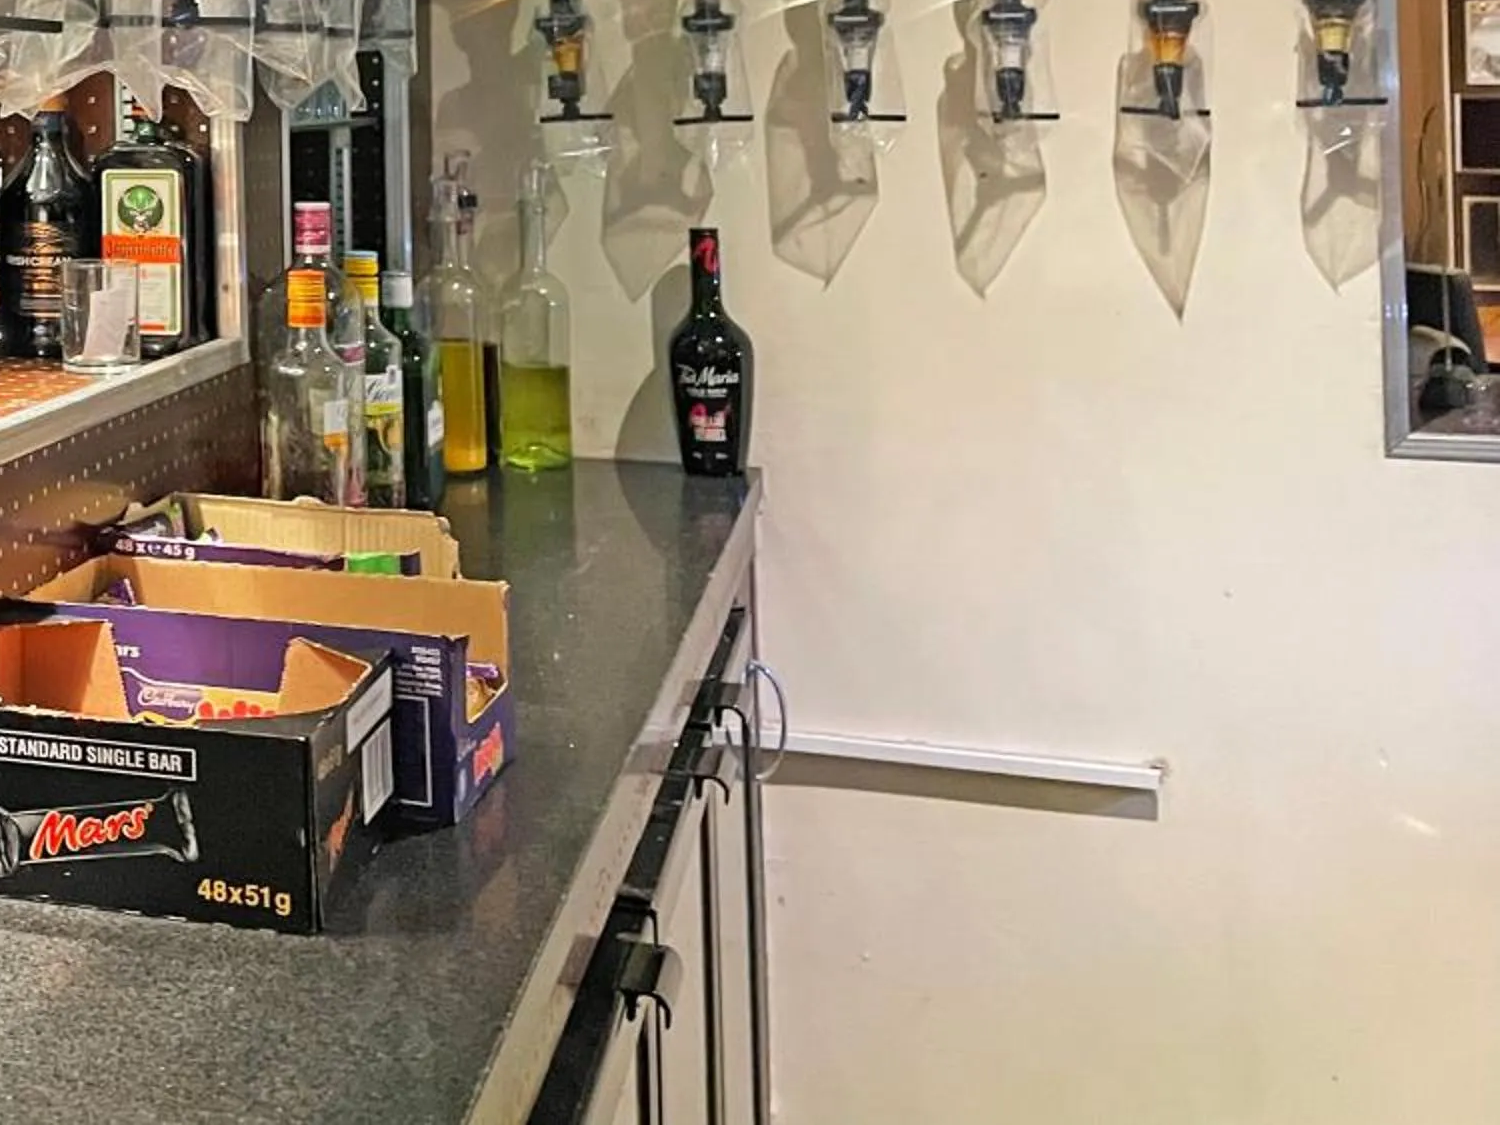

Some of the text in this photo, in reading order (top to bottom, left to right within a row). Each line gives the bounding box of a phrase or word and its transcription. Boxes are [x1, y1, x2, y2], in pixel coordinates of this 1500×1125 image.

[137, 682, 197, 715] Cadbury
[86, 745, 146, 769] SINGLE
[148, 752, 183, 773] BAR
[29, 805, 149, 861] Mars
